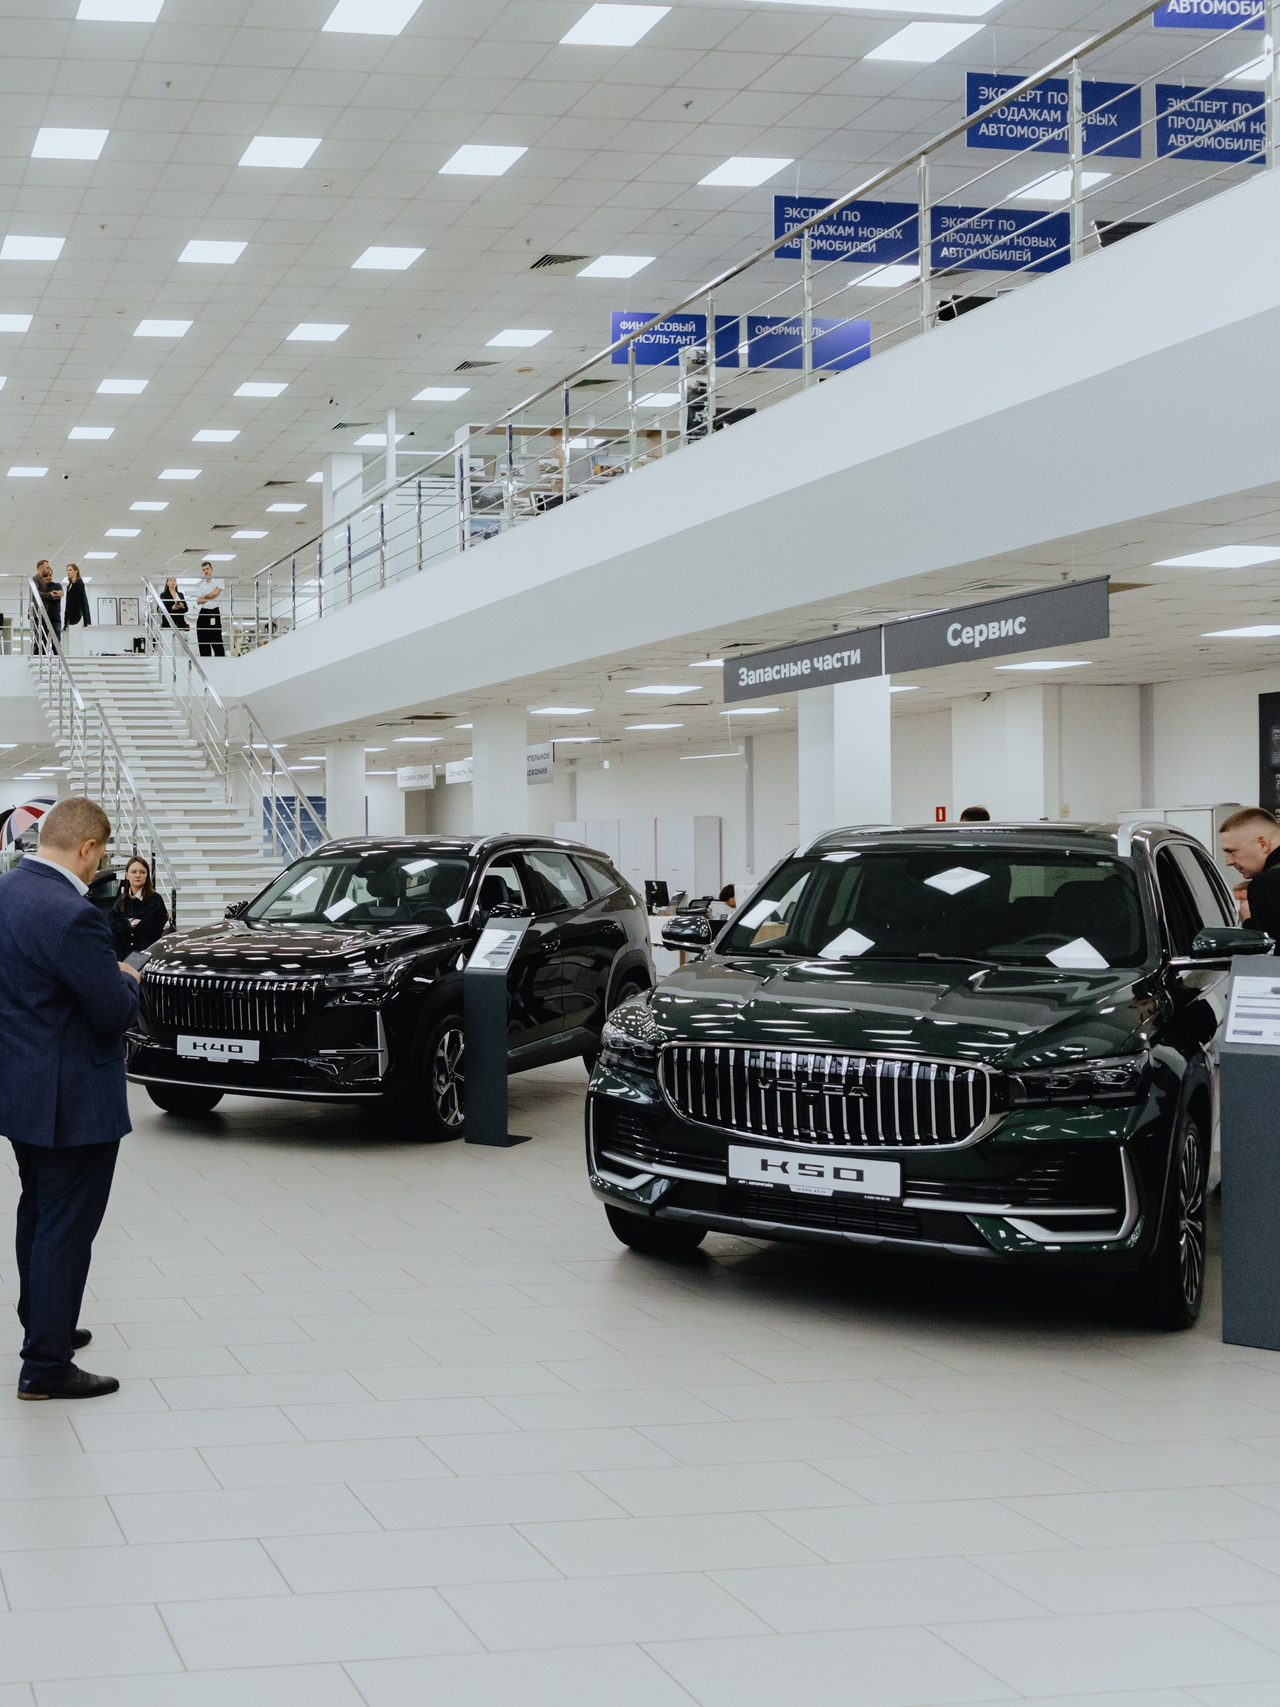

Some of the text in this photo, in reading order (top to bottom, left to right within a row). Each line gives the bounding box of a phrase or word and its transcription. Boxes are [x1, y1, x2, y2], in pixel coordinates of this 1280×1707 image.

[1167, 0, 1265, 15] АВТОМОБИ
[978, 86, 1069, 105] ЭКСЕРТ ПО
[1166, 97, 1253, 115] ЭКСПЕРТ ПО
[1167, 115, 1246, 133] ПРОДАЖАМ
[842, 210, 861, 222] ПО
[940, 216, 1016, 231] ЭКСПЕРТ ПО
[858, 226, 903, 240] НОВЫХ
[941, 231, 1057, 248] ПРОДАЖАМ НОВЫХ
[940, 246, 1032, 262] АВТОМОБИЛЕЙ
[946, 616, 1027, 648] Сервис
[738, 648, 861, 687] Запасные части
[192, 1041, 243, 1054] K40
[760, 1158, 864, 1183] K50
[795, 1186, 827, 1195] VOLGA
